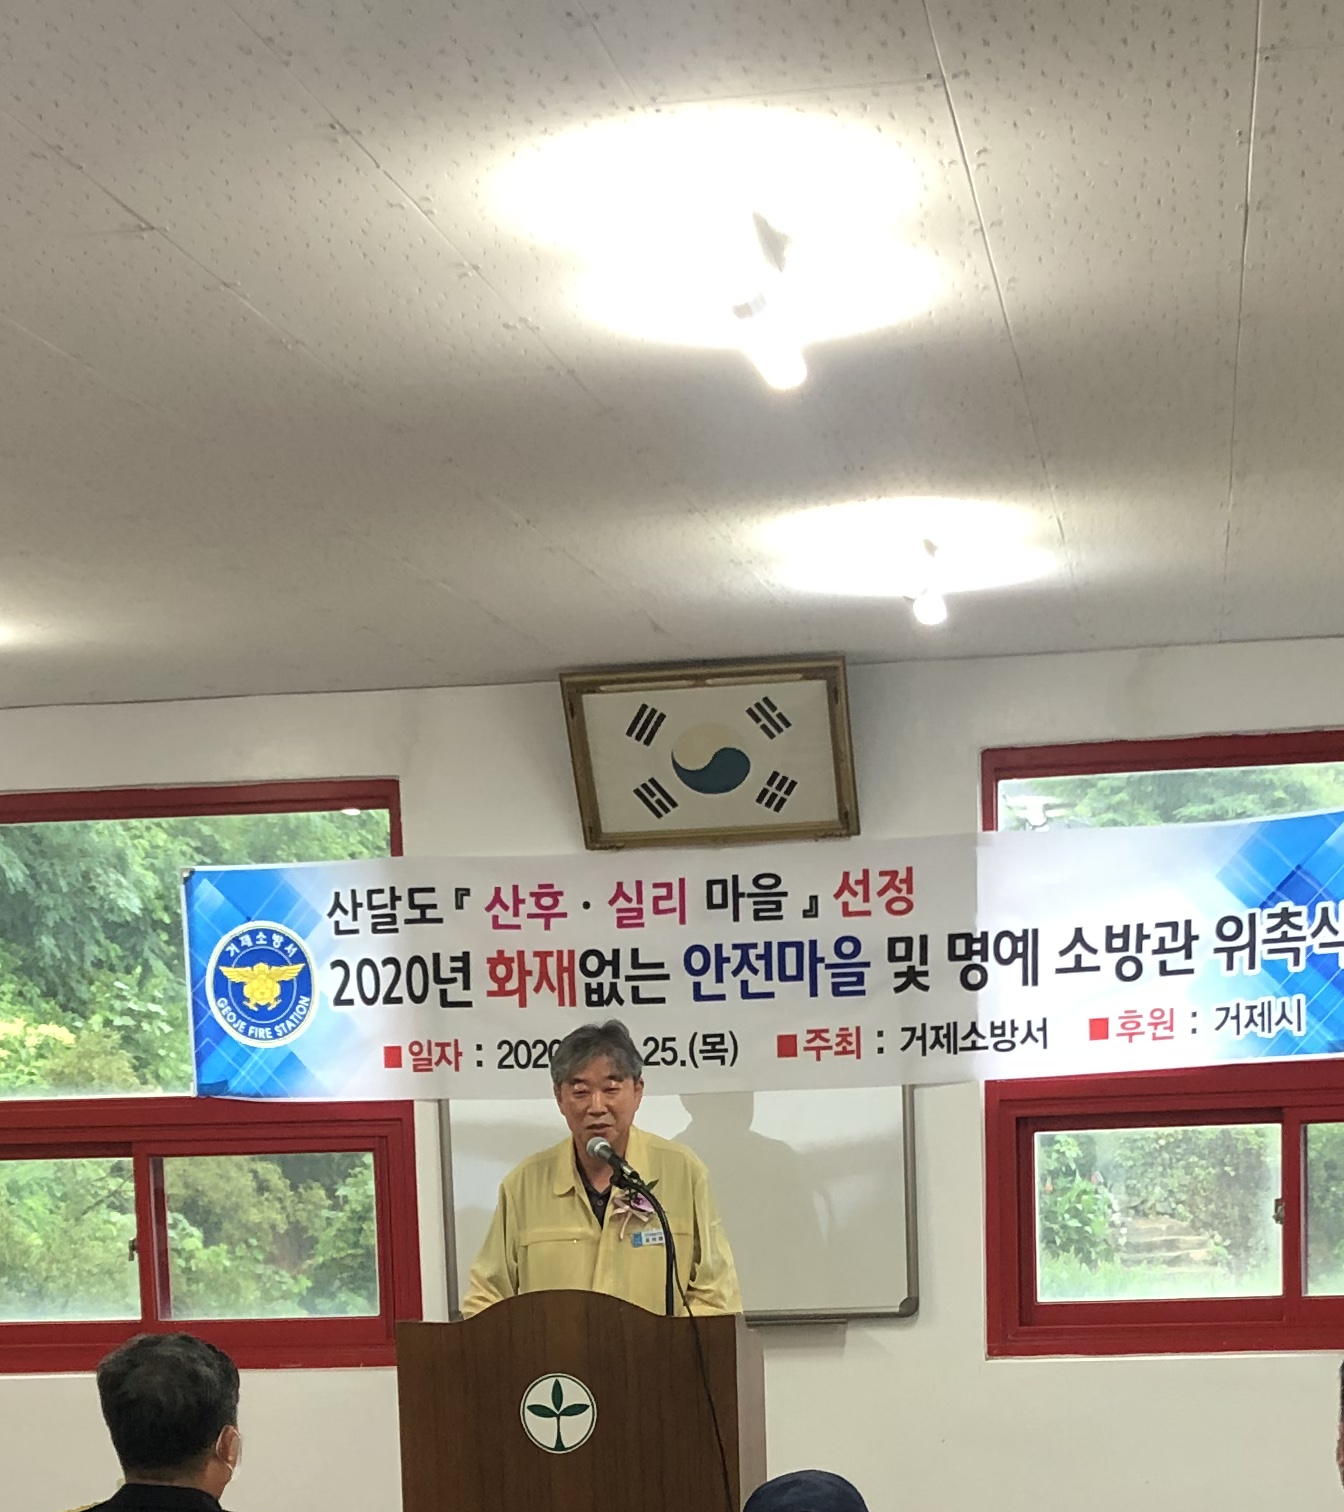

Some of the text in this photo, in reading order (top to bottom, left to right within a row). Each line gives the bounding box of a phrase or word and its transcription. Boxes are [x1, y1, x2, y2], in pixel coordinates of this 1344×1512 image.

[833, 866, 915, 918] 선정
[225, 931, 298, 958] 거제소방서
[329, 950, 474, 1008] 2020년
[486, 947, 671, 1008] 화재없는
[683, 935, 871, 1003] 안전마을
[887, 933, 930, 994] 및
[947, 926, 1040, 992] 명예
[1055, 919, 1200, 982] 소방관
[216, 996, 311, 1039] GEOJE FIRE STATION
[900, 1017, 1049, 1056] 거제소방서
[1214, 998, 1303, 1037] 거제시
